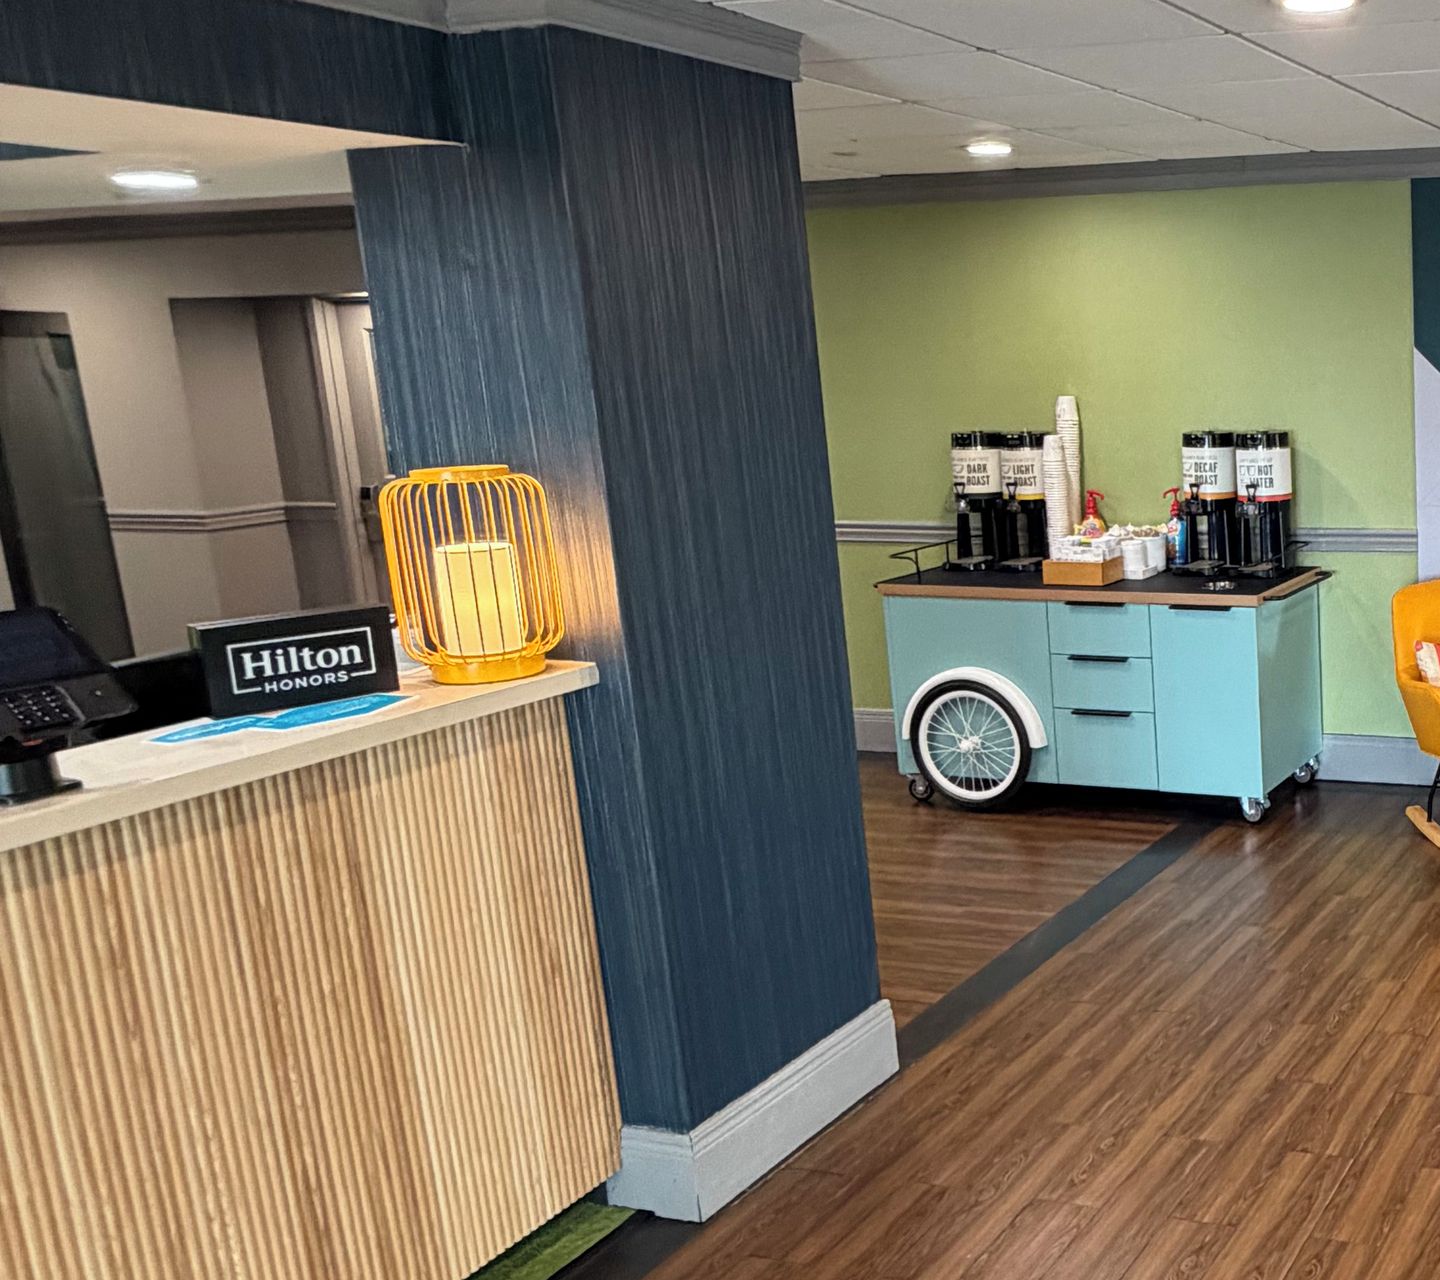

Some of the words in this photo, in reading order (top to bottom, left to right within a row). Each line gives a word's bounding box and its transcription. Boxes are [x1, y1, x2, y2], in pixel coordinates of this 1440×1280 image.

[966, 463, 988, 474] DARK
[1012, 463, 1035, 475] LIGHT
[1194, 462, 1218, 473] DECAF
[1257, 464, 1273, 476] HOT
[966, 475, 990, 486] ROAST
[1194, 474, 1218, 485] ROAST
[240, 644, 363, 680] Hilton
[265, 671, 349, 693] HONORS
